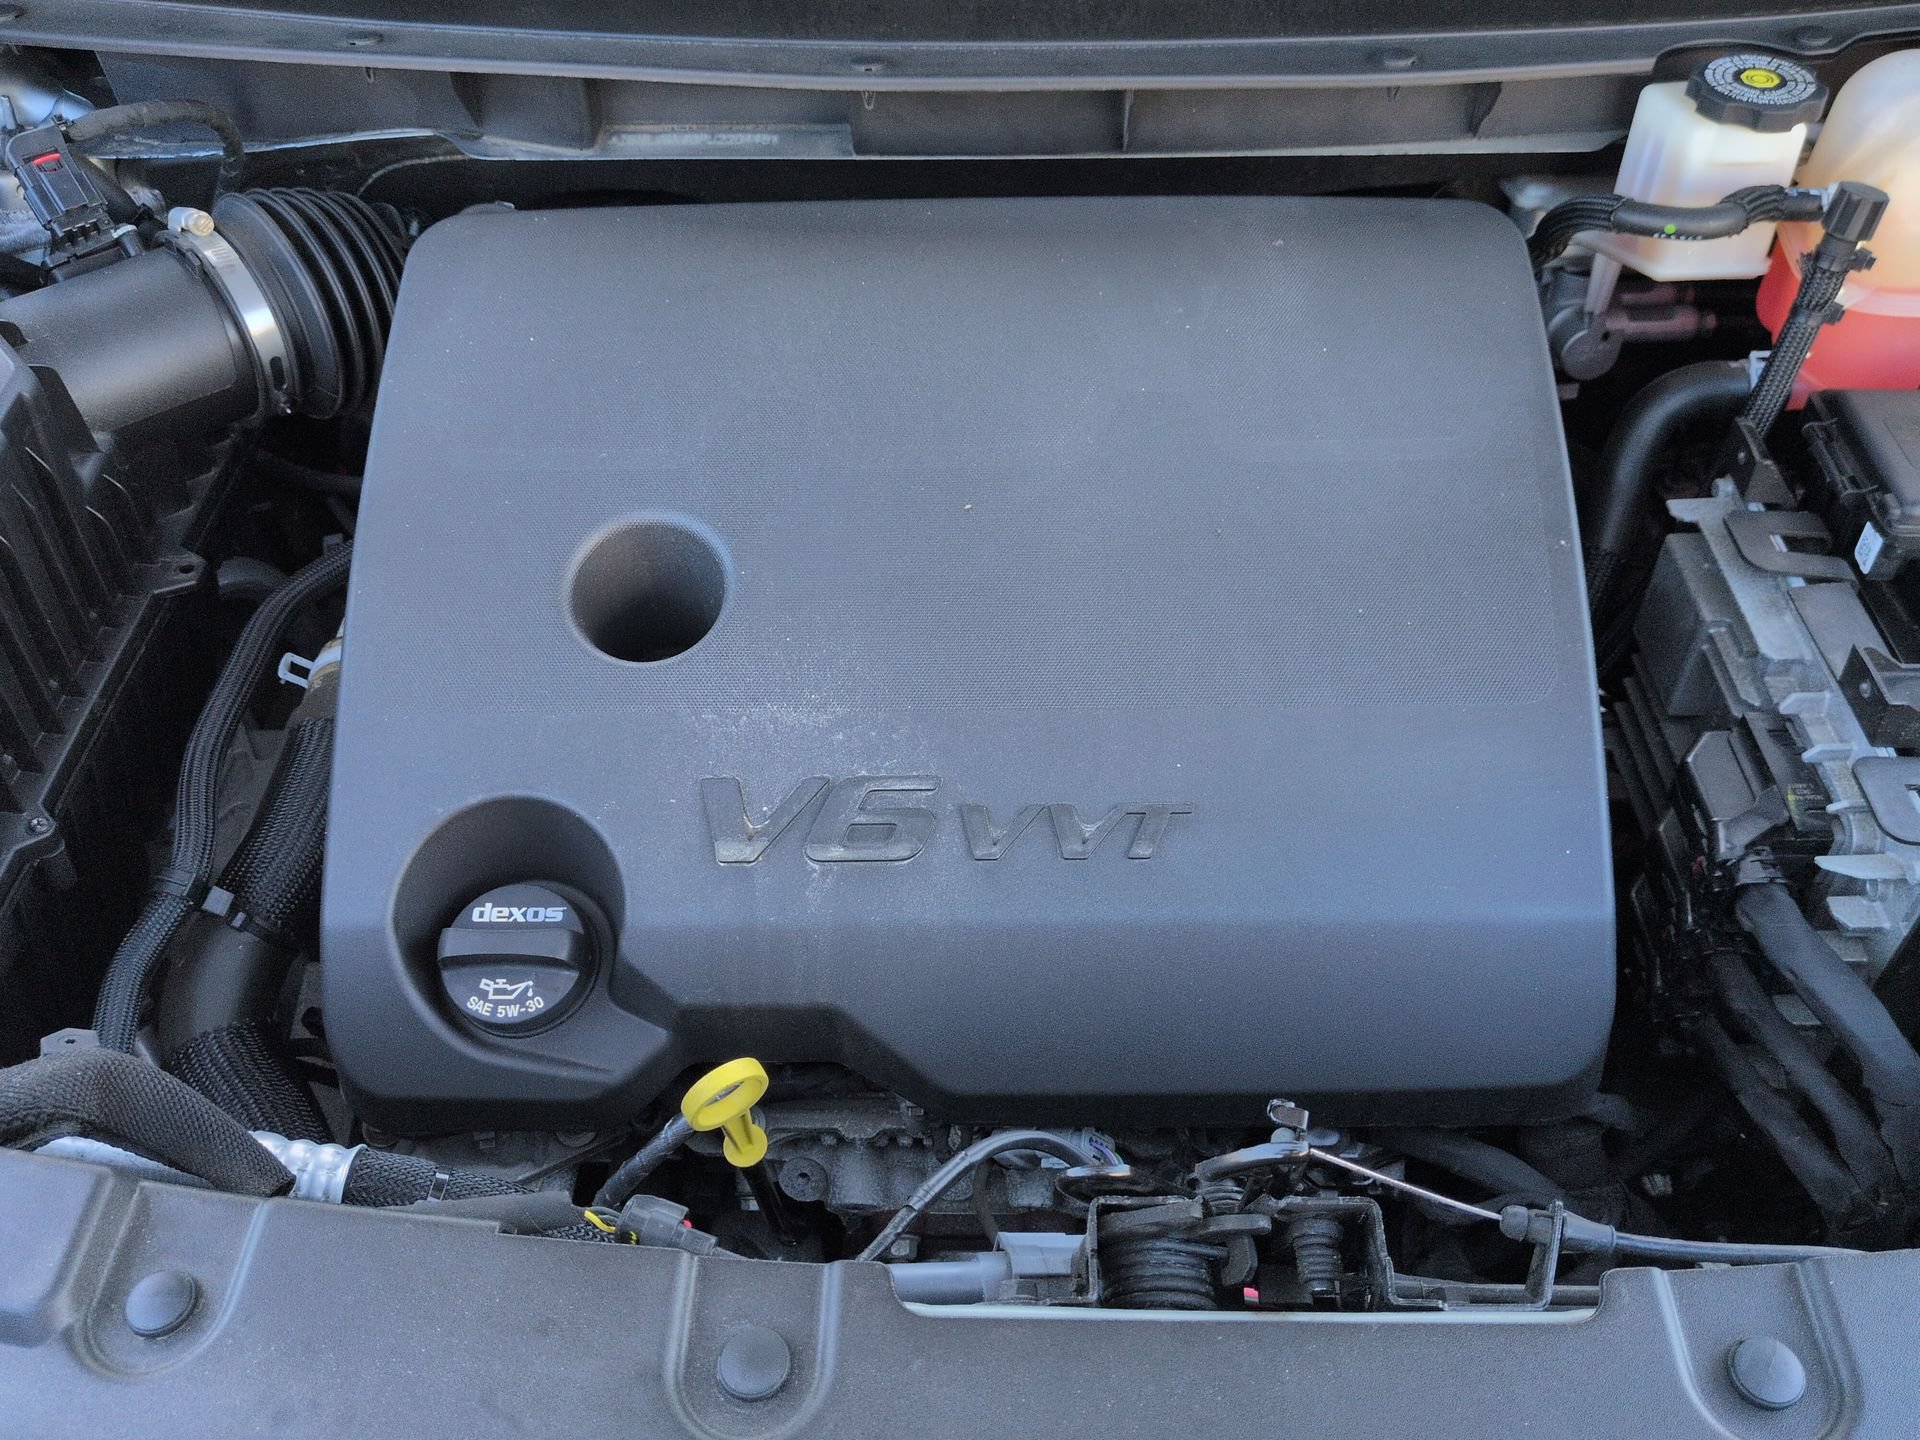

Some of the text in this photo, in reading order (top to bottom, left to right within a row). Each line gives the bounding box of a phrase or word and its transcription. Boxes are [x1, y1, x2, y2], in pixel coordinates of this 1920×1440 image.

[700, 775, 1193, 864] V6 VVT
[472, 902, 566, 922] dexos
[467, 996, 544, 1017] SAE 5W-30
